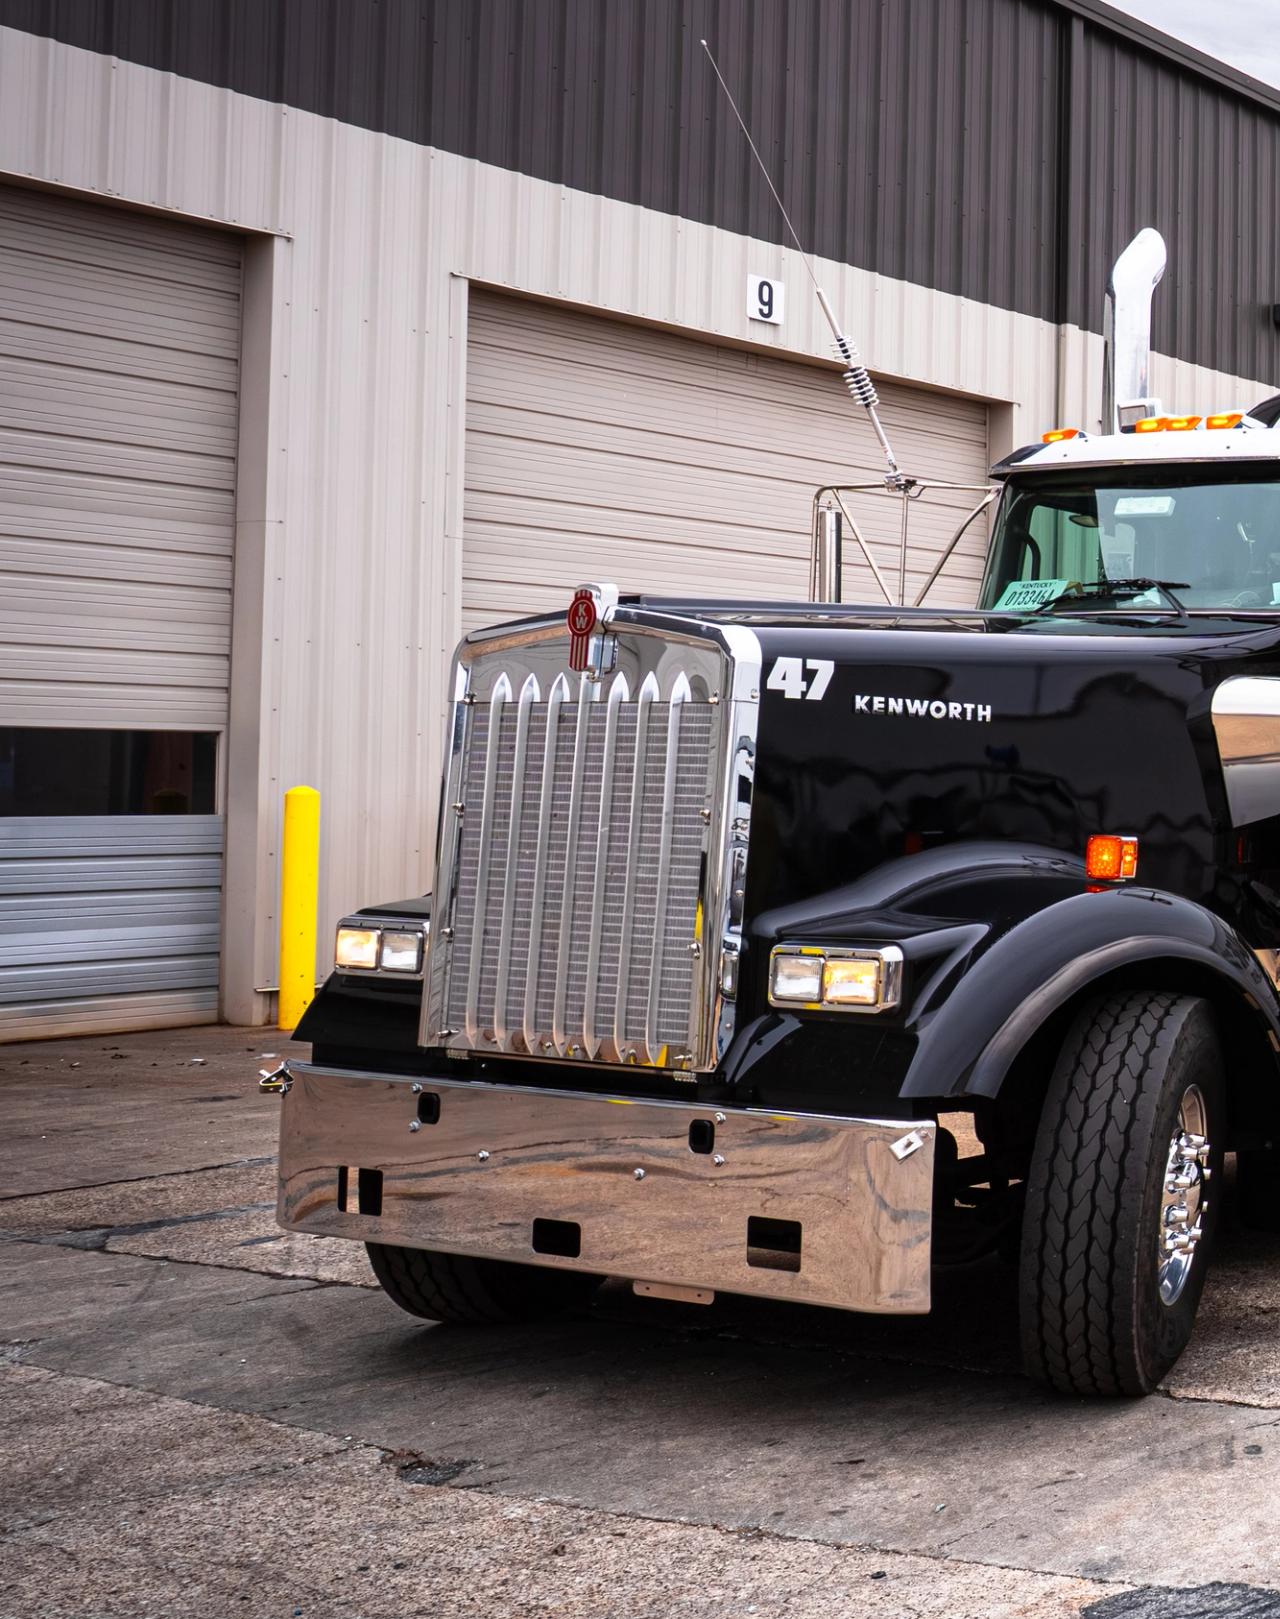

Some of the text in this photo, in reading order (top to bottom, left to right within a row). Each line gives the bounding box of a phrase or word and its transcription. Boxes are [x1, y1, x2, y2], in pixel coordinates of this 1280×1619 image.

[758, 280, 773, 319] 9
[767, 656, 834, 700] 47
[855, 694, 992, 722] KENWORTH
